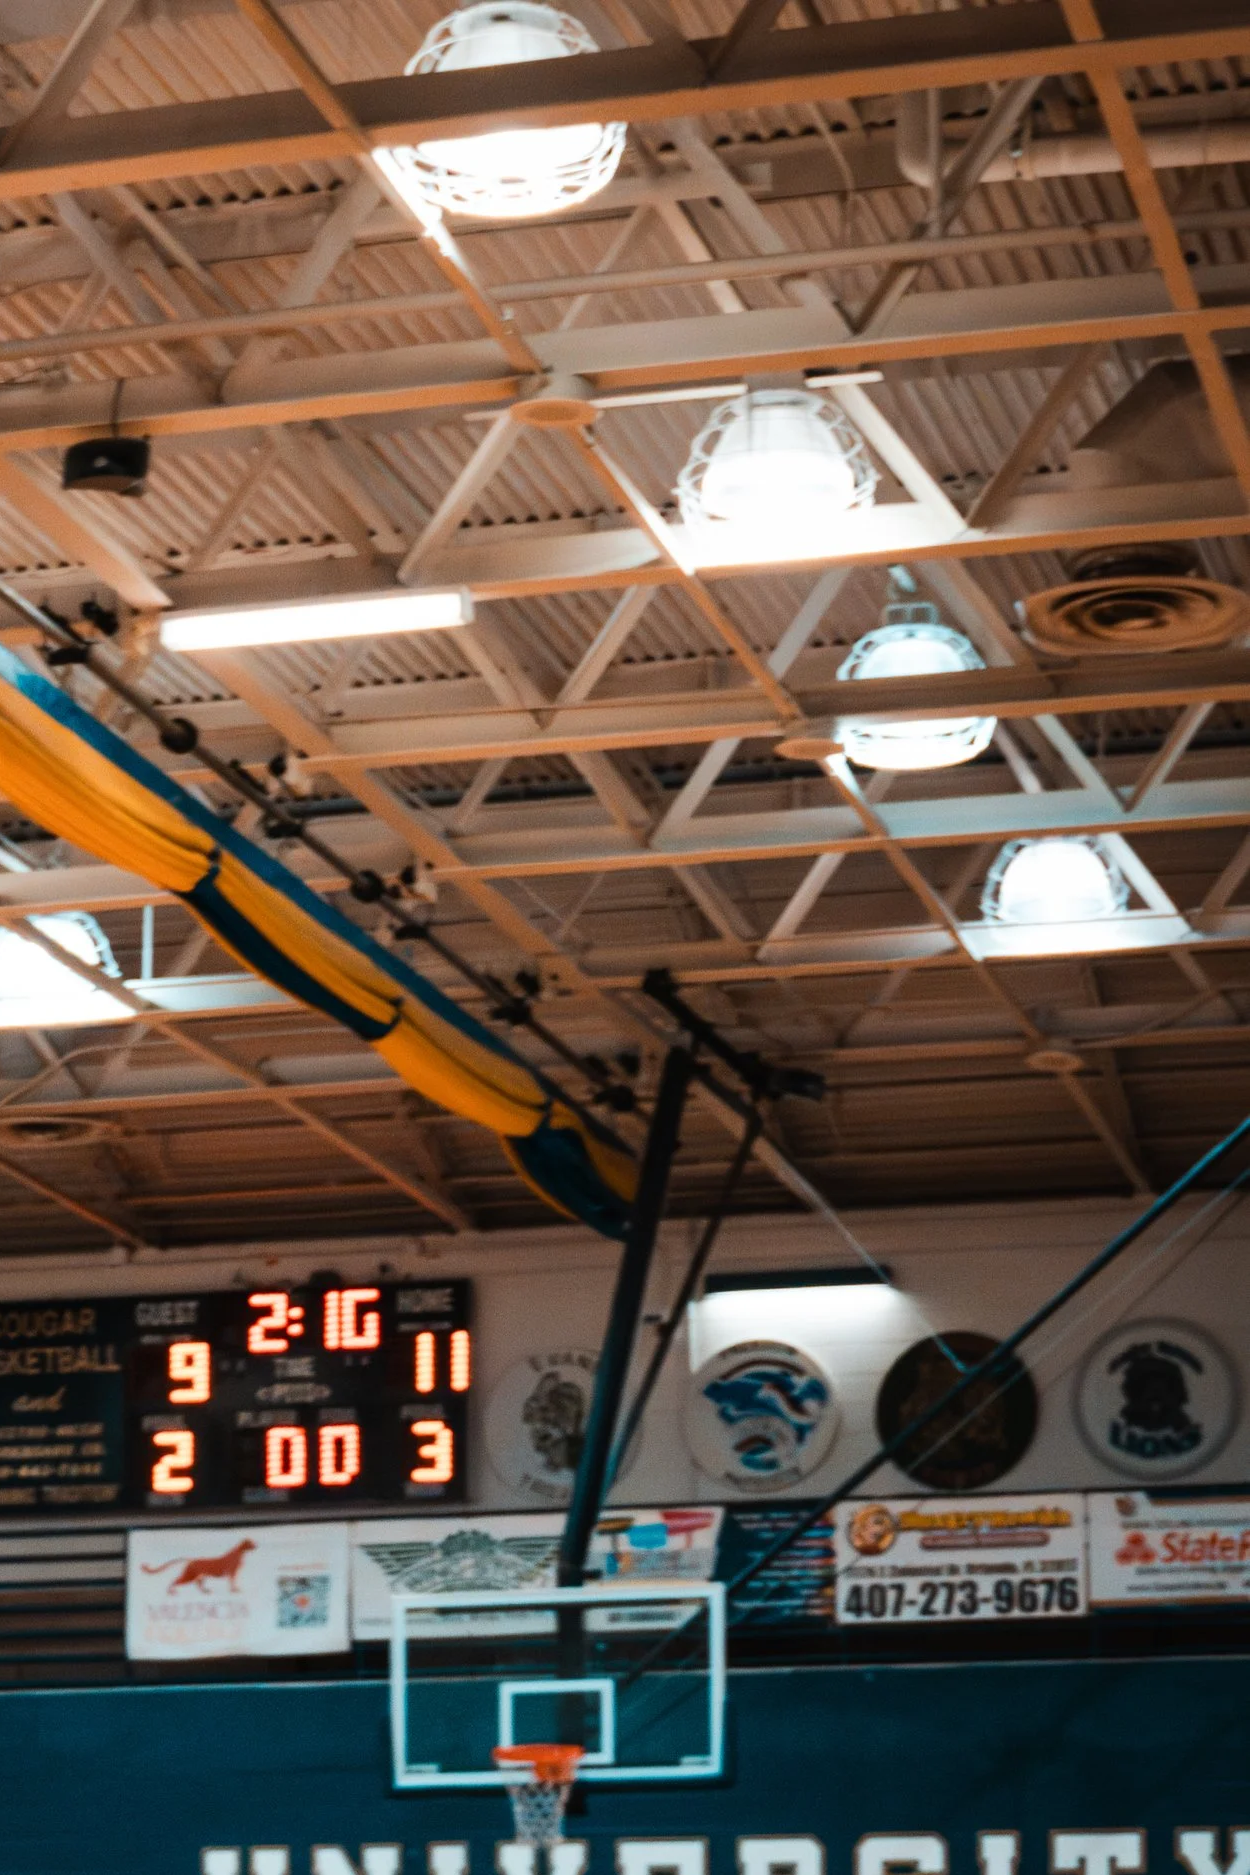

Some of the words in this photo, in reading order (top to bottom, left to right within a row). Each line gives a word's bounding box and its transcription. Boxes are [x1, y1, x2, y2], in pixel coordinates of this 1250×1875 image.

[169, 1341, 211, 1405] 9
[415, 1330, 470, 1393] 11
[11, 1384, 67, 1412] and
[151, 1430, 195, 1493] 2
[410, 1420, 454, 1483] 3
[843, 1577, 1080, 1618] 407-273-9676
